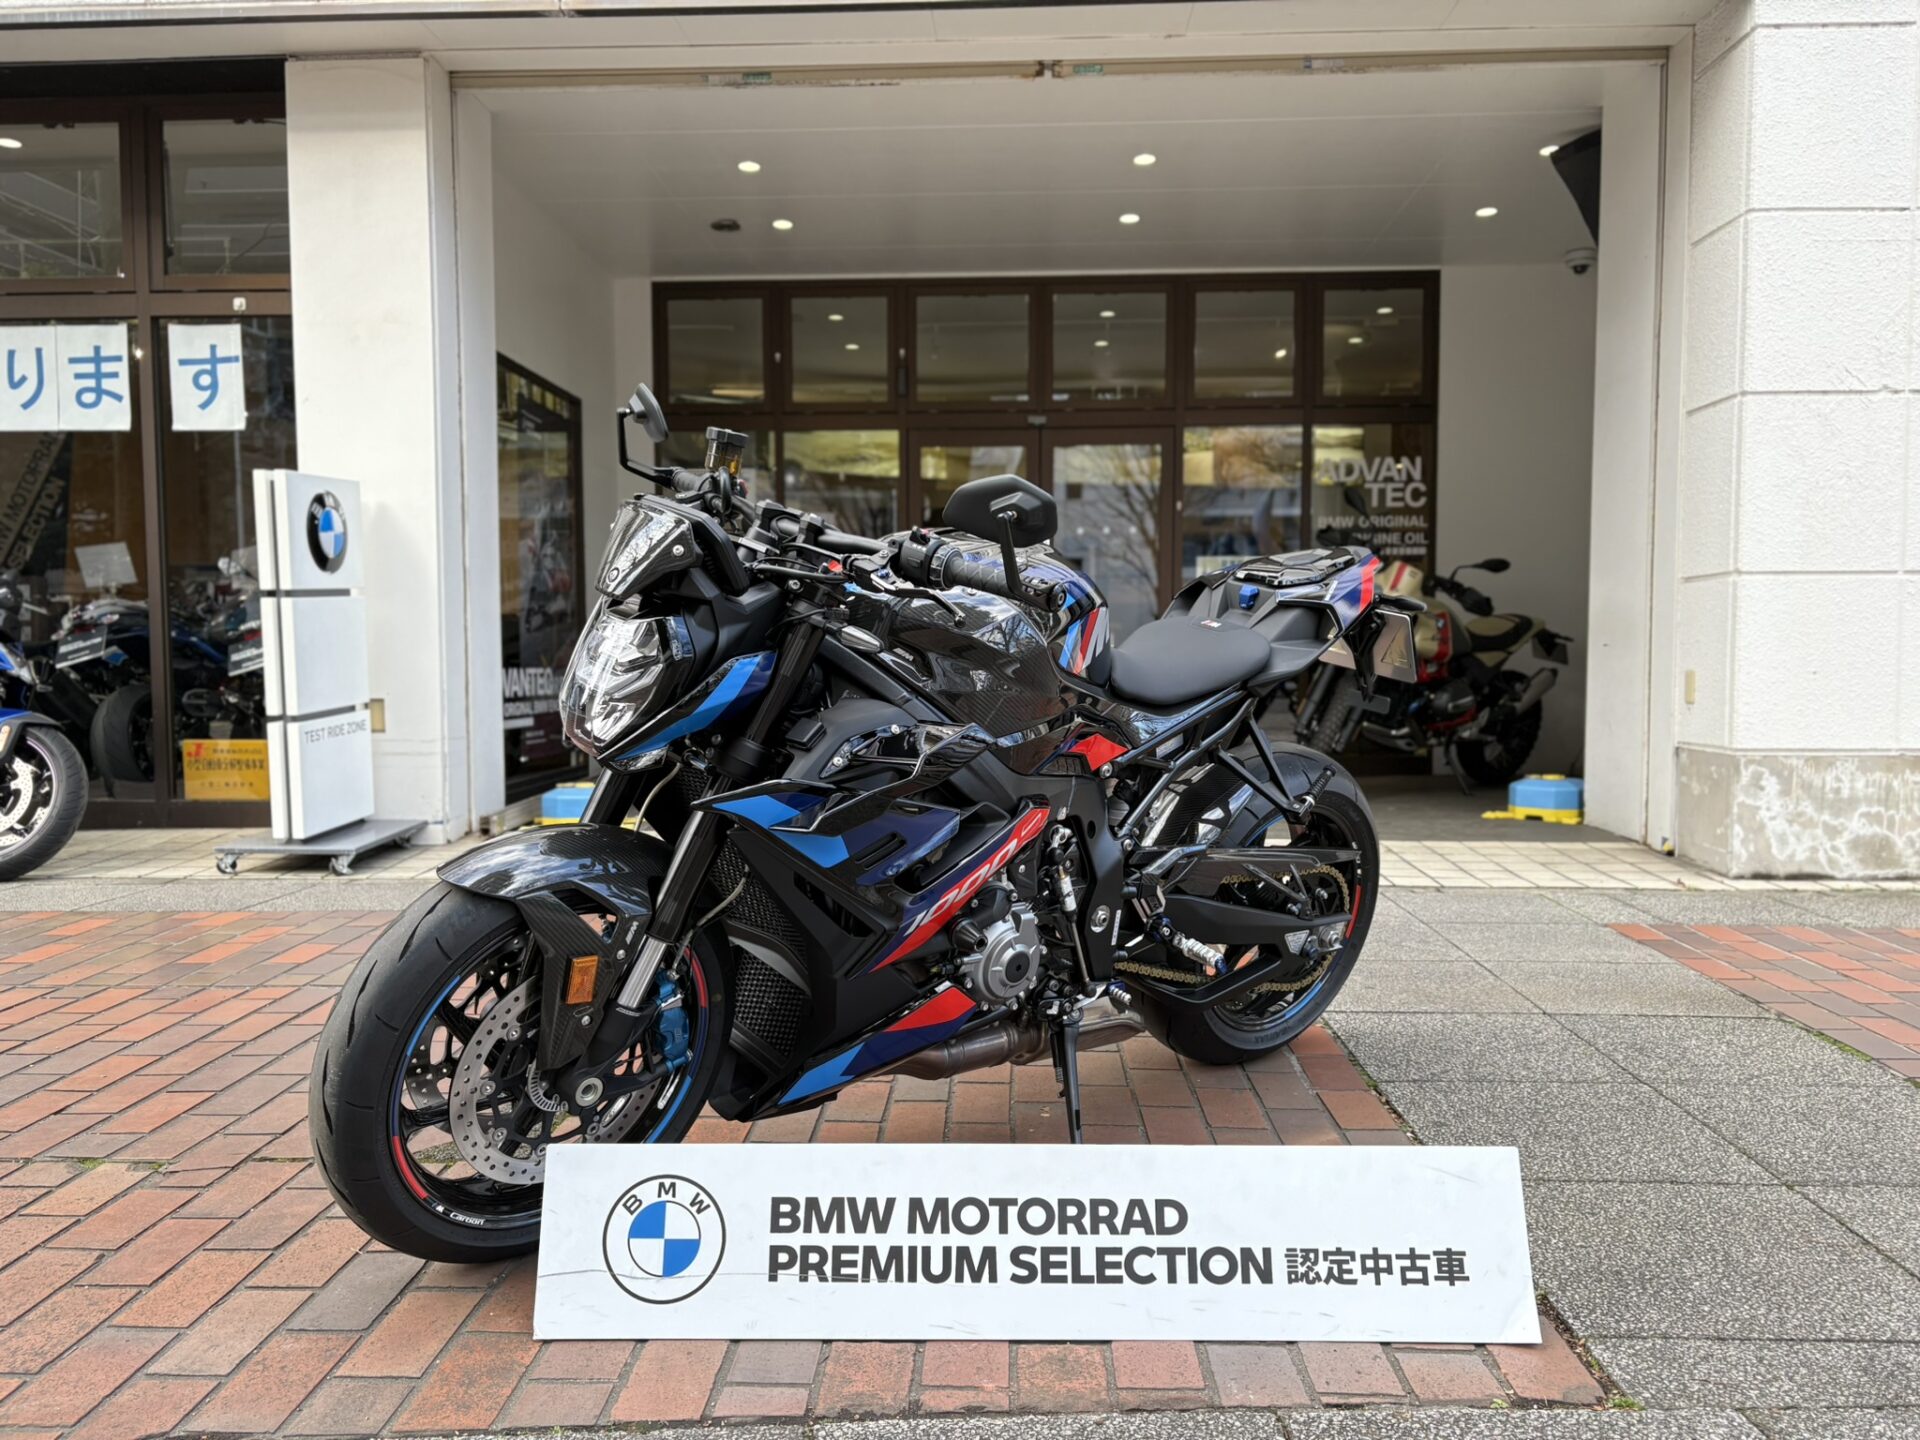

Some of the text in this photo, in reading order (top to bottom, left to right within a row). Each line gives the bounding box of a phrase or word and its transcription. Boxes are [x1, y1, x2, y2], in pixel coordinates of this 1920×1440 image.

[1319, 455, 1423, 482] ADVAN
[1364, 482, 1428, 508] TEC
[1358, 515, 1429, 529] ORIGINAL
[1404, 532, 1429, 545] OIL
[304, 719, 368, 744] TEST RIDE ZONE
[621, 1181, 711, 1217] BMW
[450, 1211, 486, 1226] Carbon
[770, 1196, 1188, 1235] BMW MOTORRAD
[768, 1244, 1469, 1286] PREMIUM SELECTION 認定中古車
